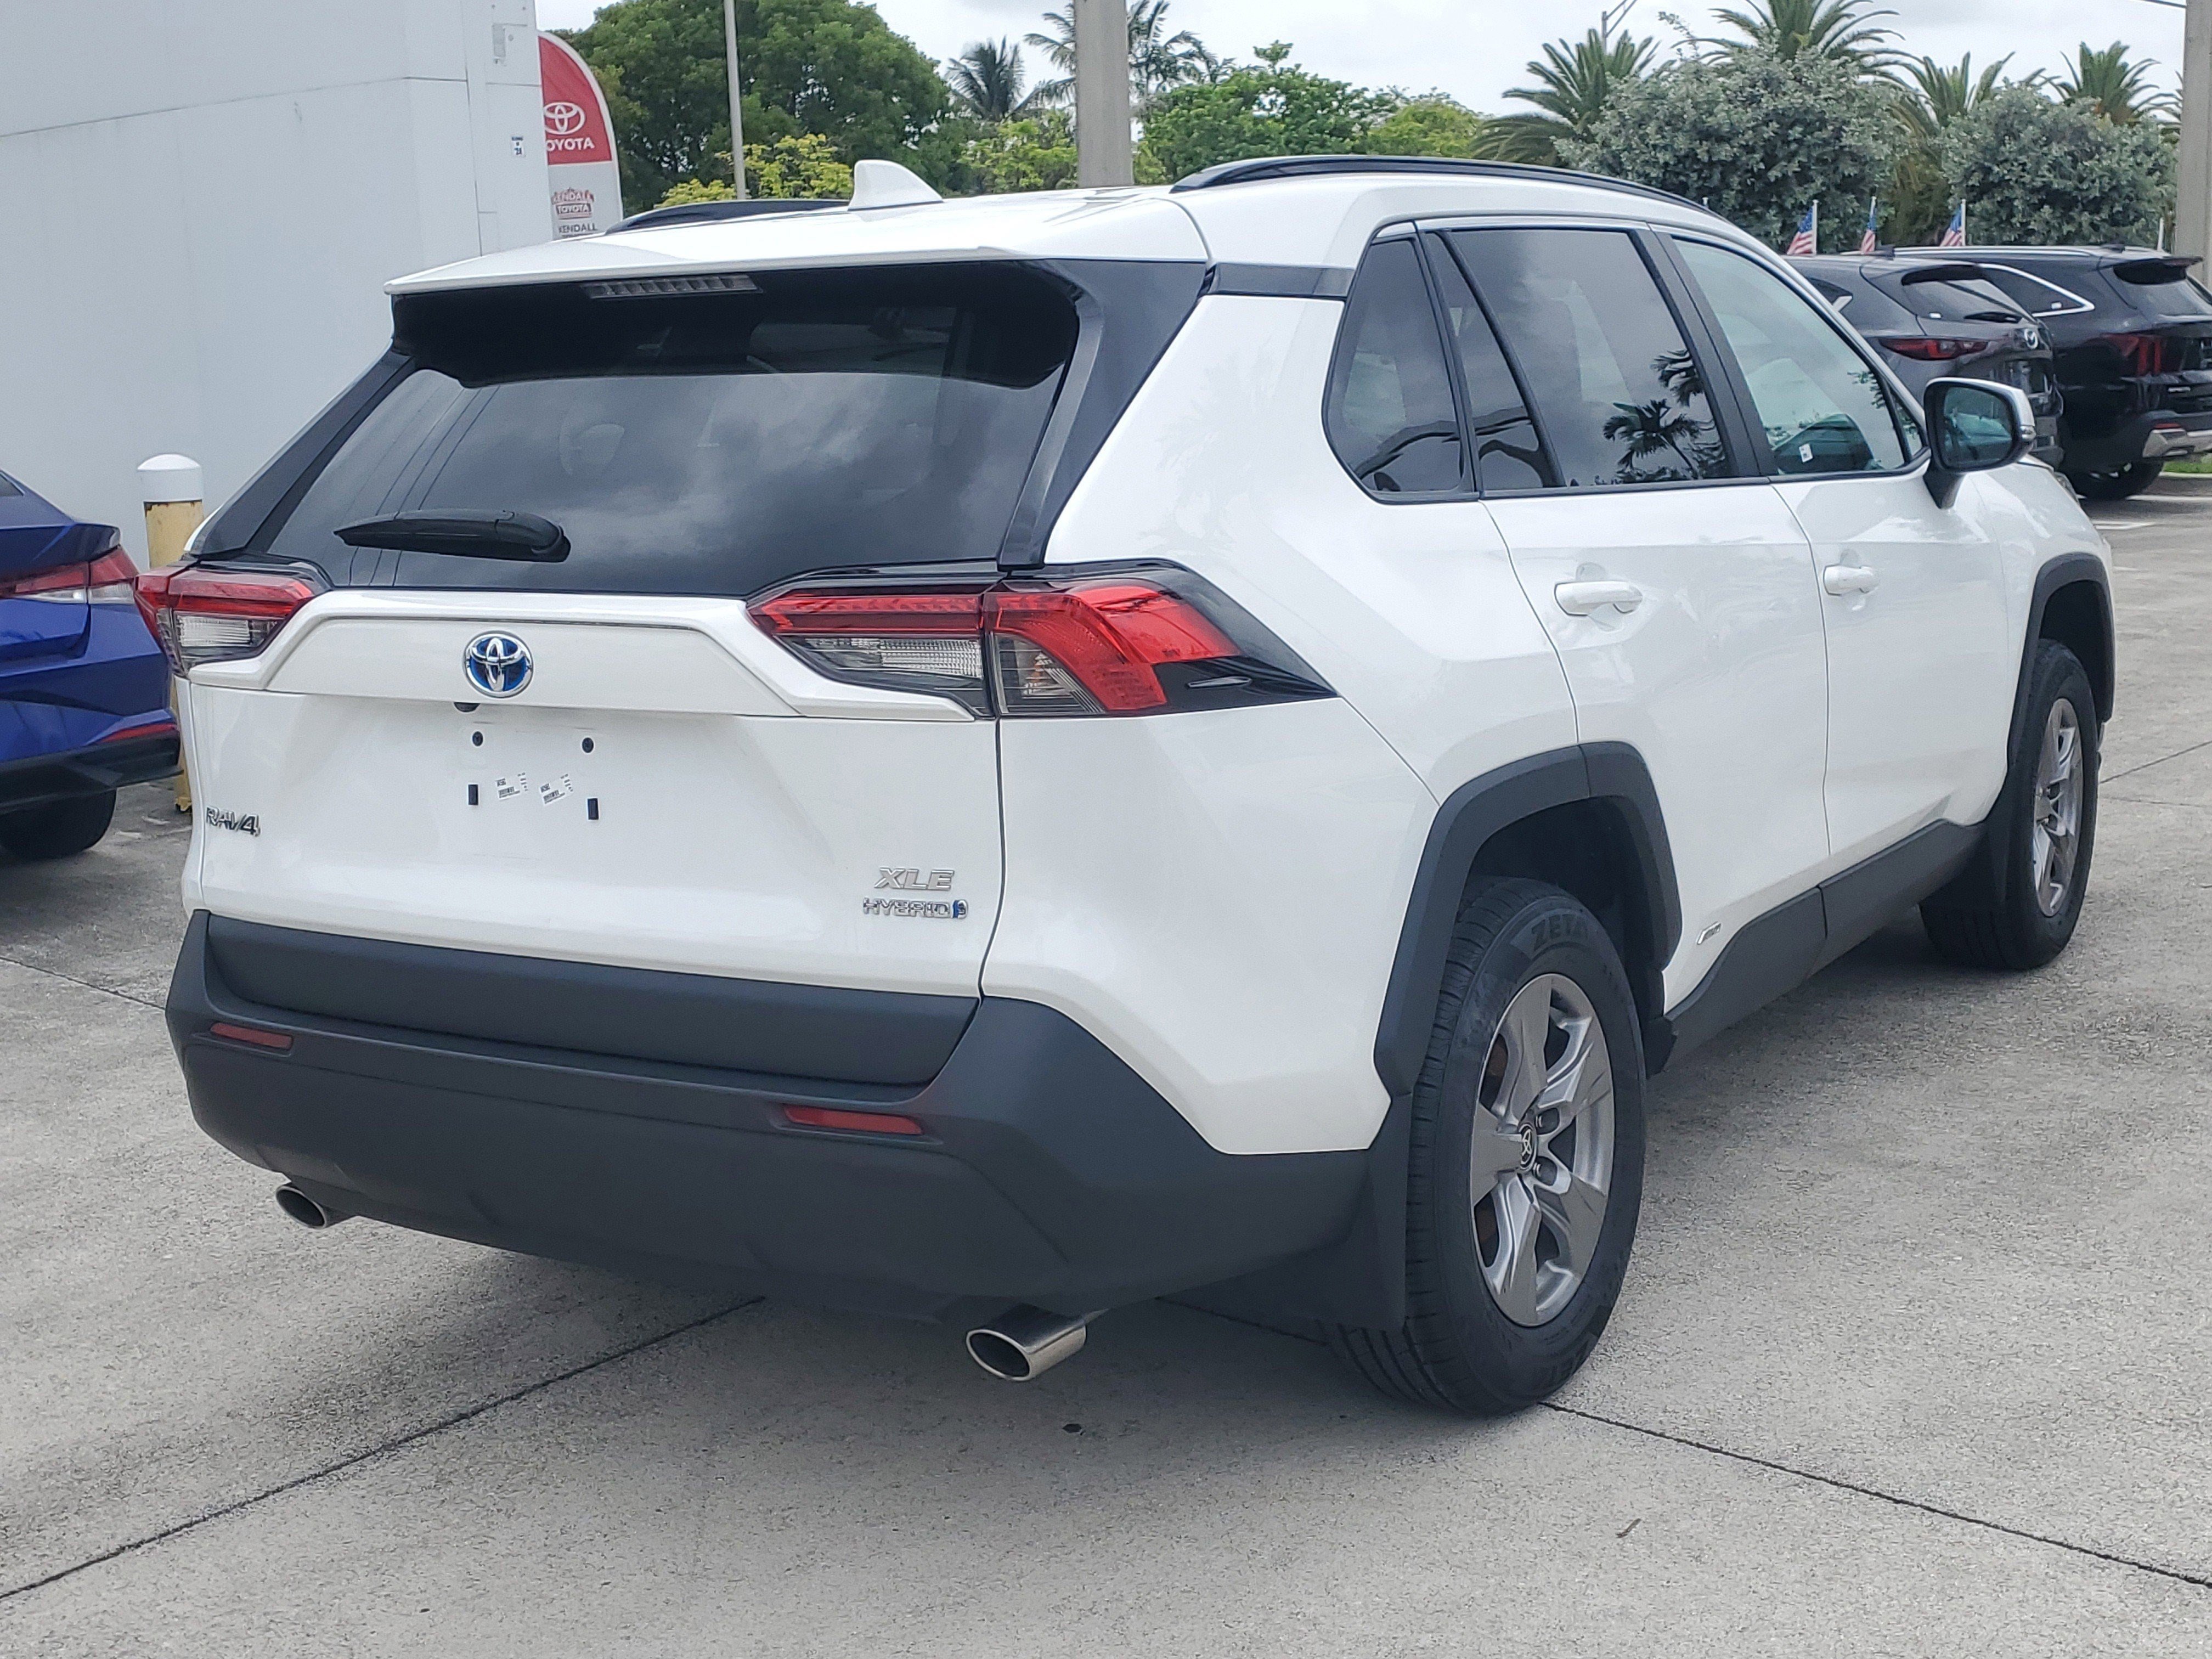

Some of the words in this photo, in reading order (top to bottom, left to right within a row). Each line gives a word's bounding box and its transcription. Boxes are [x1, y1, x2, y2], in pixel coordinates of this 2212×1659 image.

[546, 137, 595, 152] OYOTA
[557, 204, 590, 214] TOYOTA
[558, 223, 598, 234] KENDALL
[206, 806, 261, 837] RAV4
[874, 867, 955, 891] XLE
[863, 898, 950, 919] HYBRID
